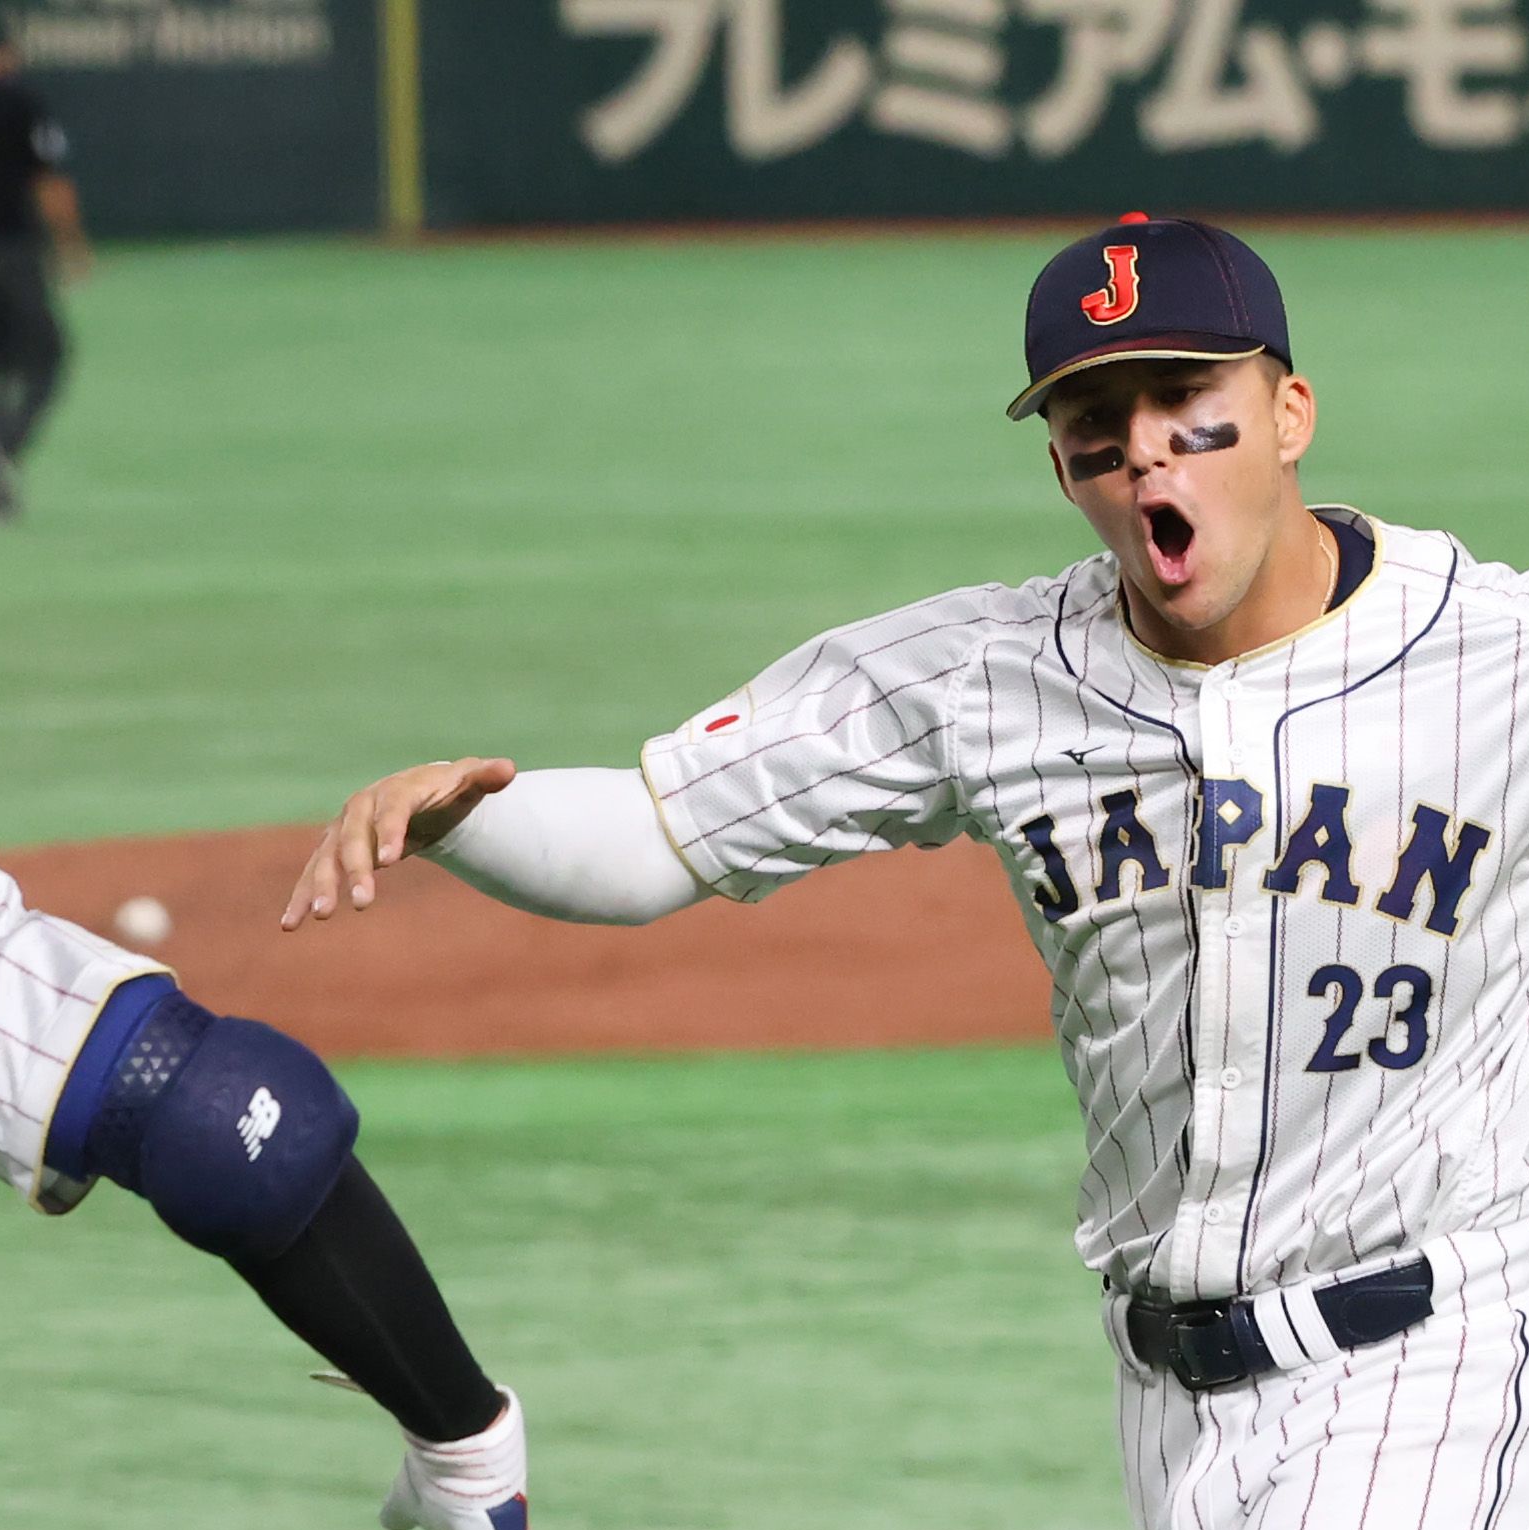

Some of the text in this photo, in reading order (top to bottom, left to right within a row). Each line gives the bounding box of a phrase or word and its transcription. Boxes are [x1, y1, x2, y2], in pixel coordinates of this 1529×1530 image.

[1080, 244, 1141, 326] J
[1016, 775, 1493, 942] JAPAN
[1304, 963, 1435, 1074] 23
